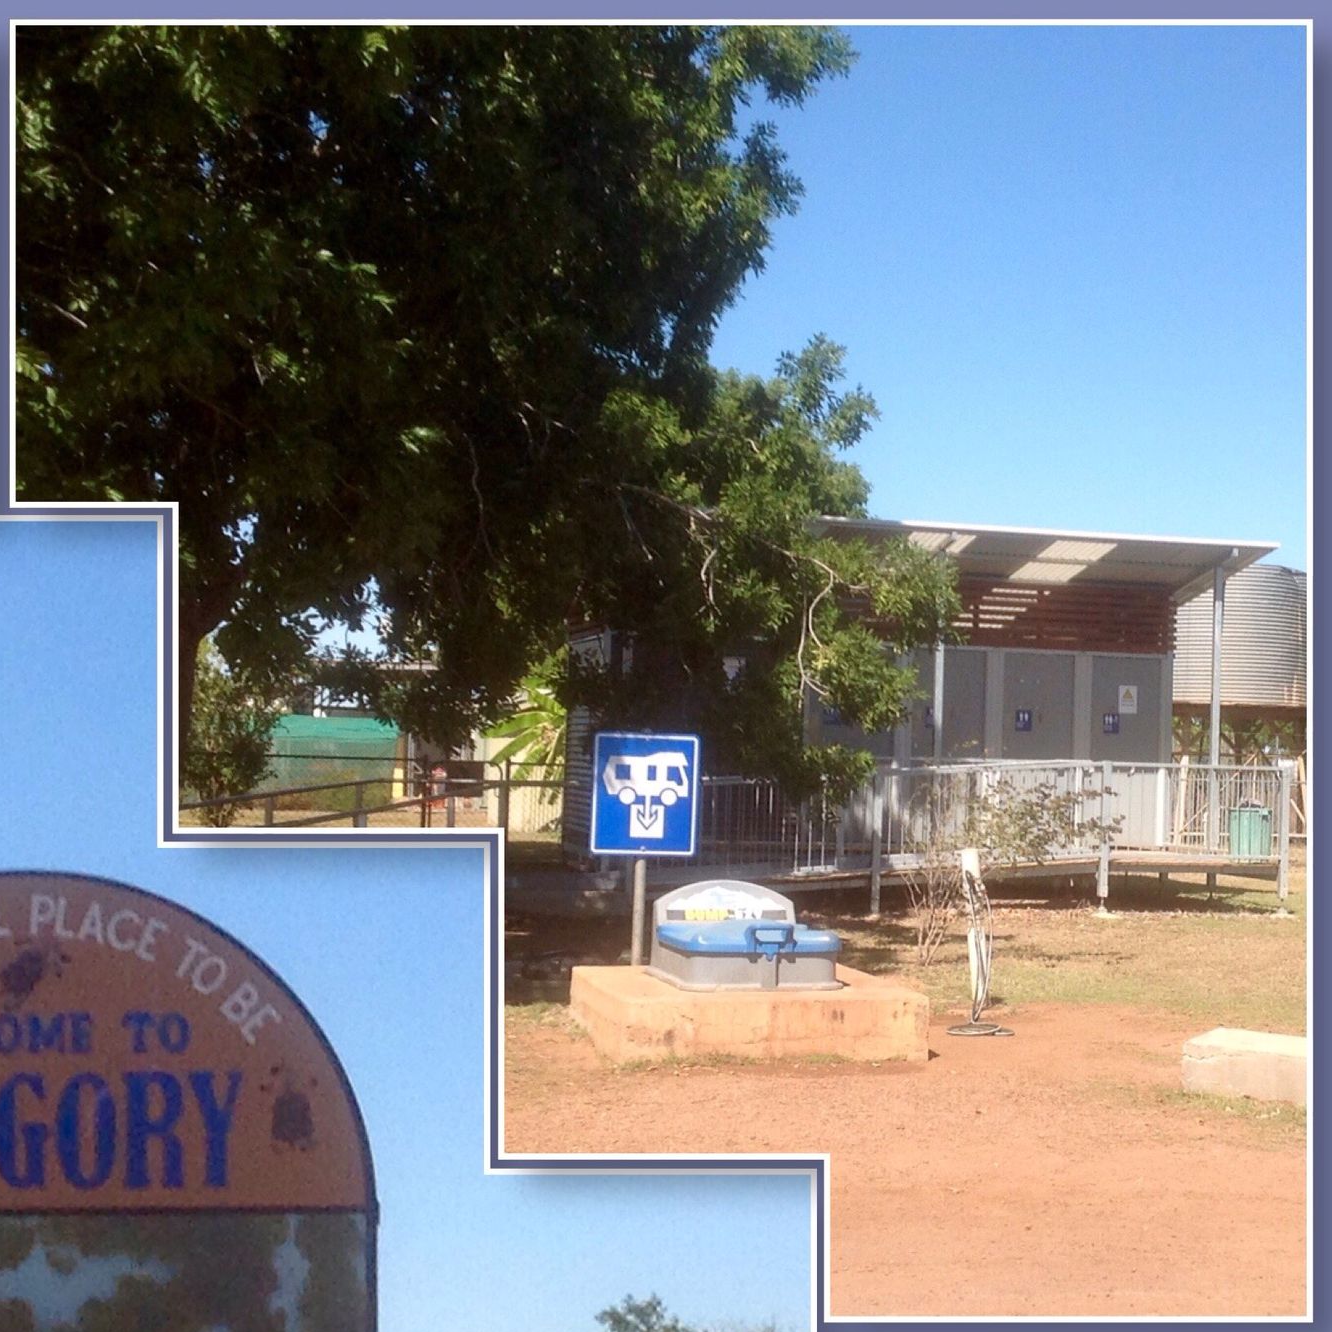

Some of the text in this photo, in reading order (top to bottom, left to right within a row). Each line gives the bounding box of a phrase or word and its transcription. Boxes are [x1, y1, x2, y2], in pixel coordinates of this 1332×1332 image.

[29, 894, 167, 962] PLACE
[175, 936, 226, 995] TO
[219, 982, 282, 1047] BE
[121, 1009, 192, 1055] TO
